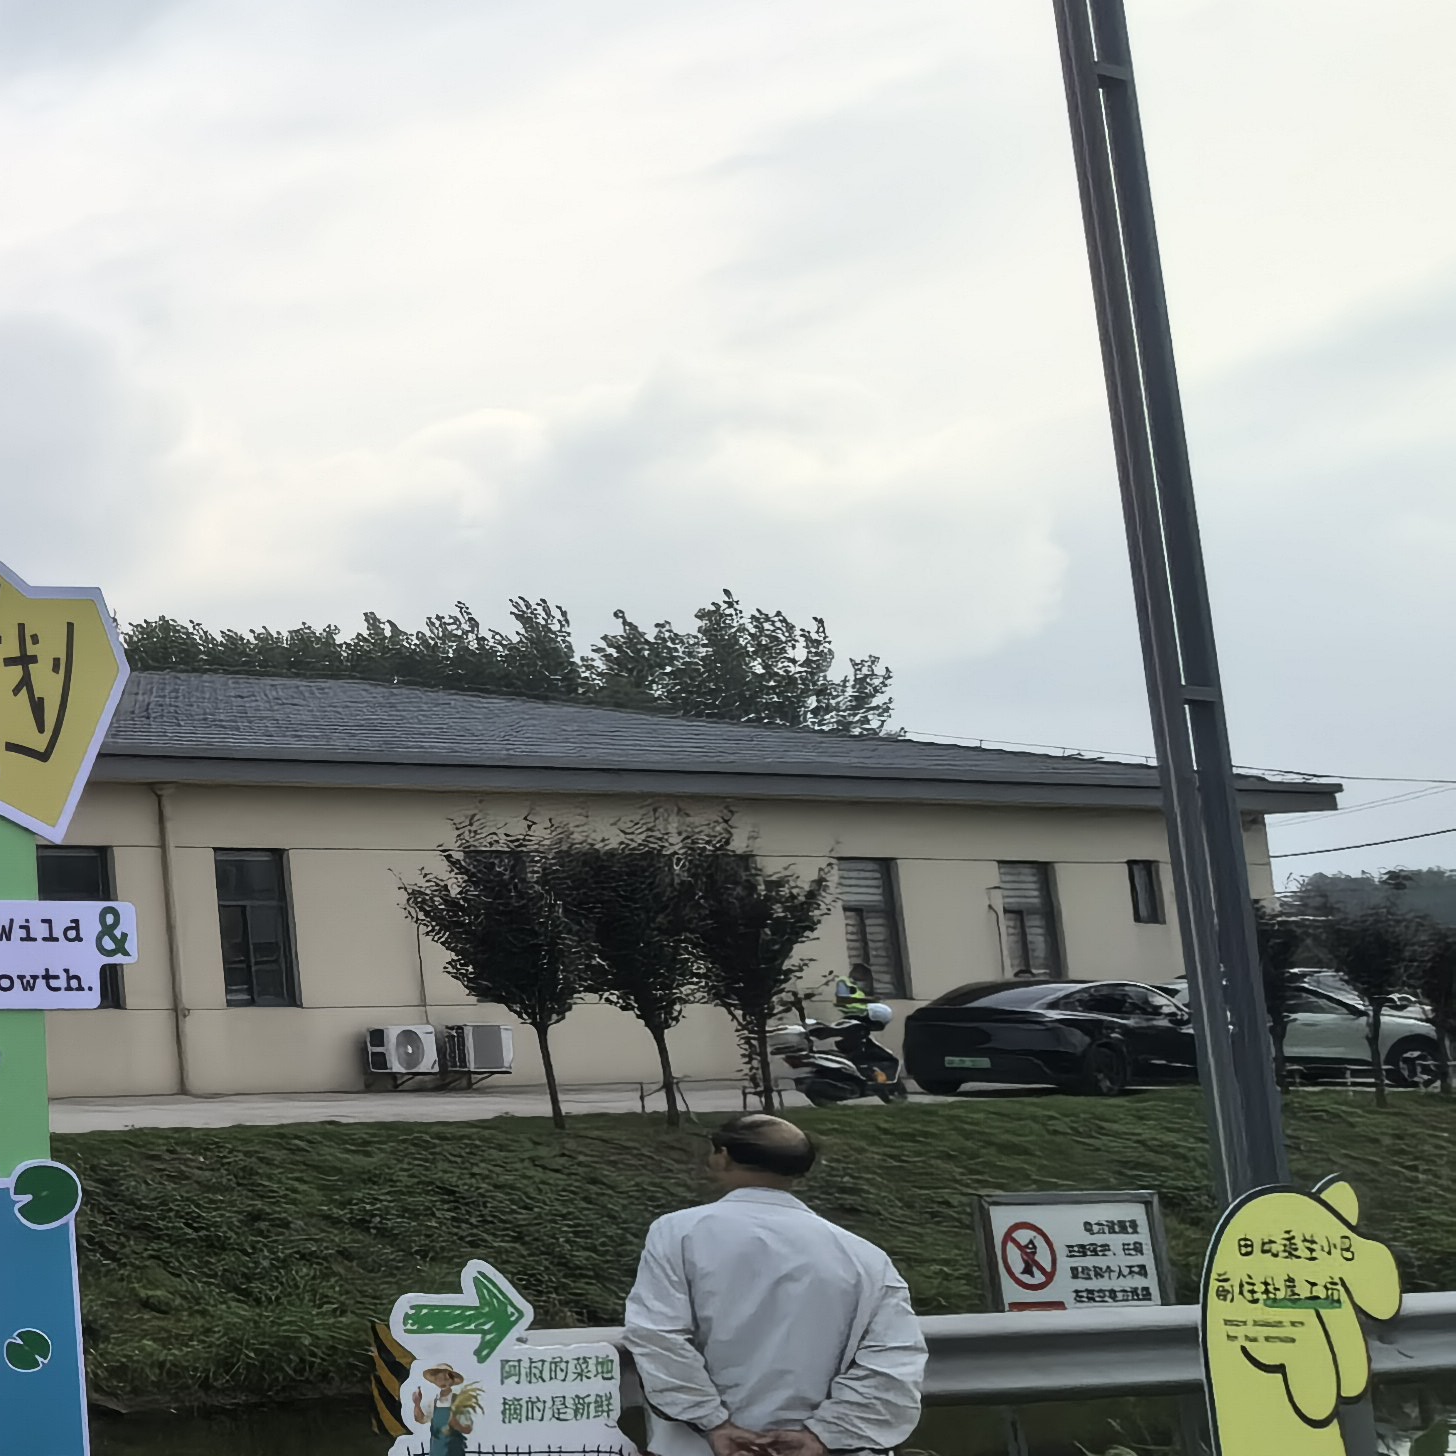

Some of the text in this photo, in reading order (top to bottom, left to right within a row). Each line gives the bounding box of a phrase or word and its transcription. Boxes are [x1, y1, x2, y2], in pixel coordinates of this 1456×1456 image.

[95, 905, 133, 959] &
[499, 1353, 616, 1386] 阿叔的菜地
